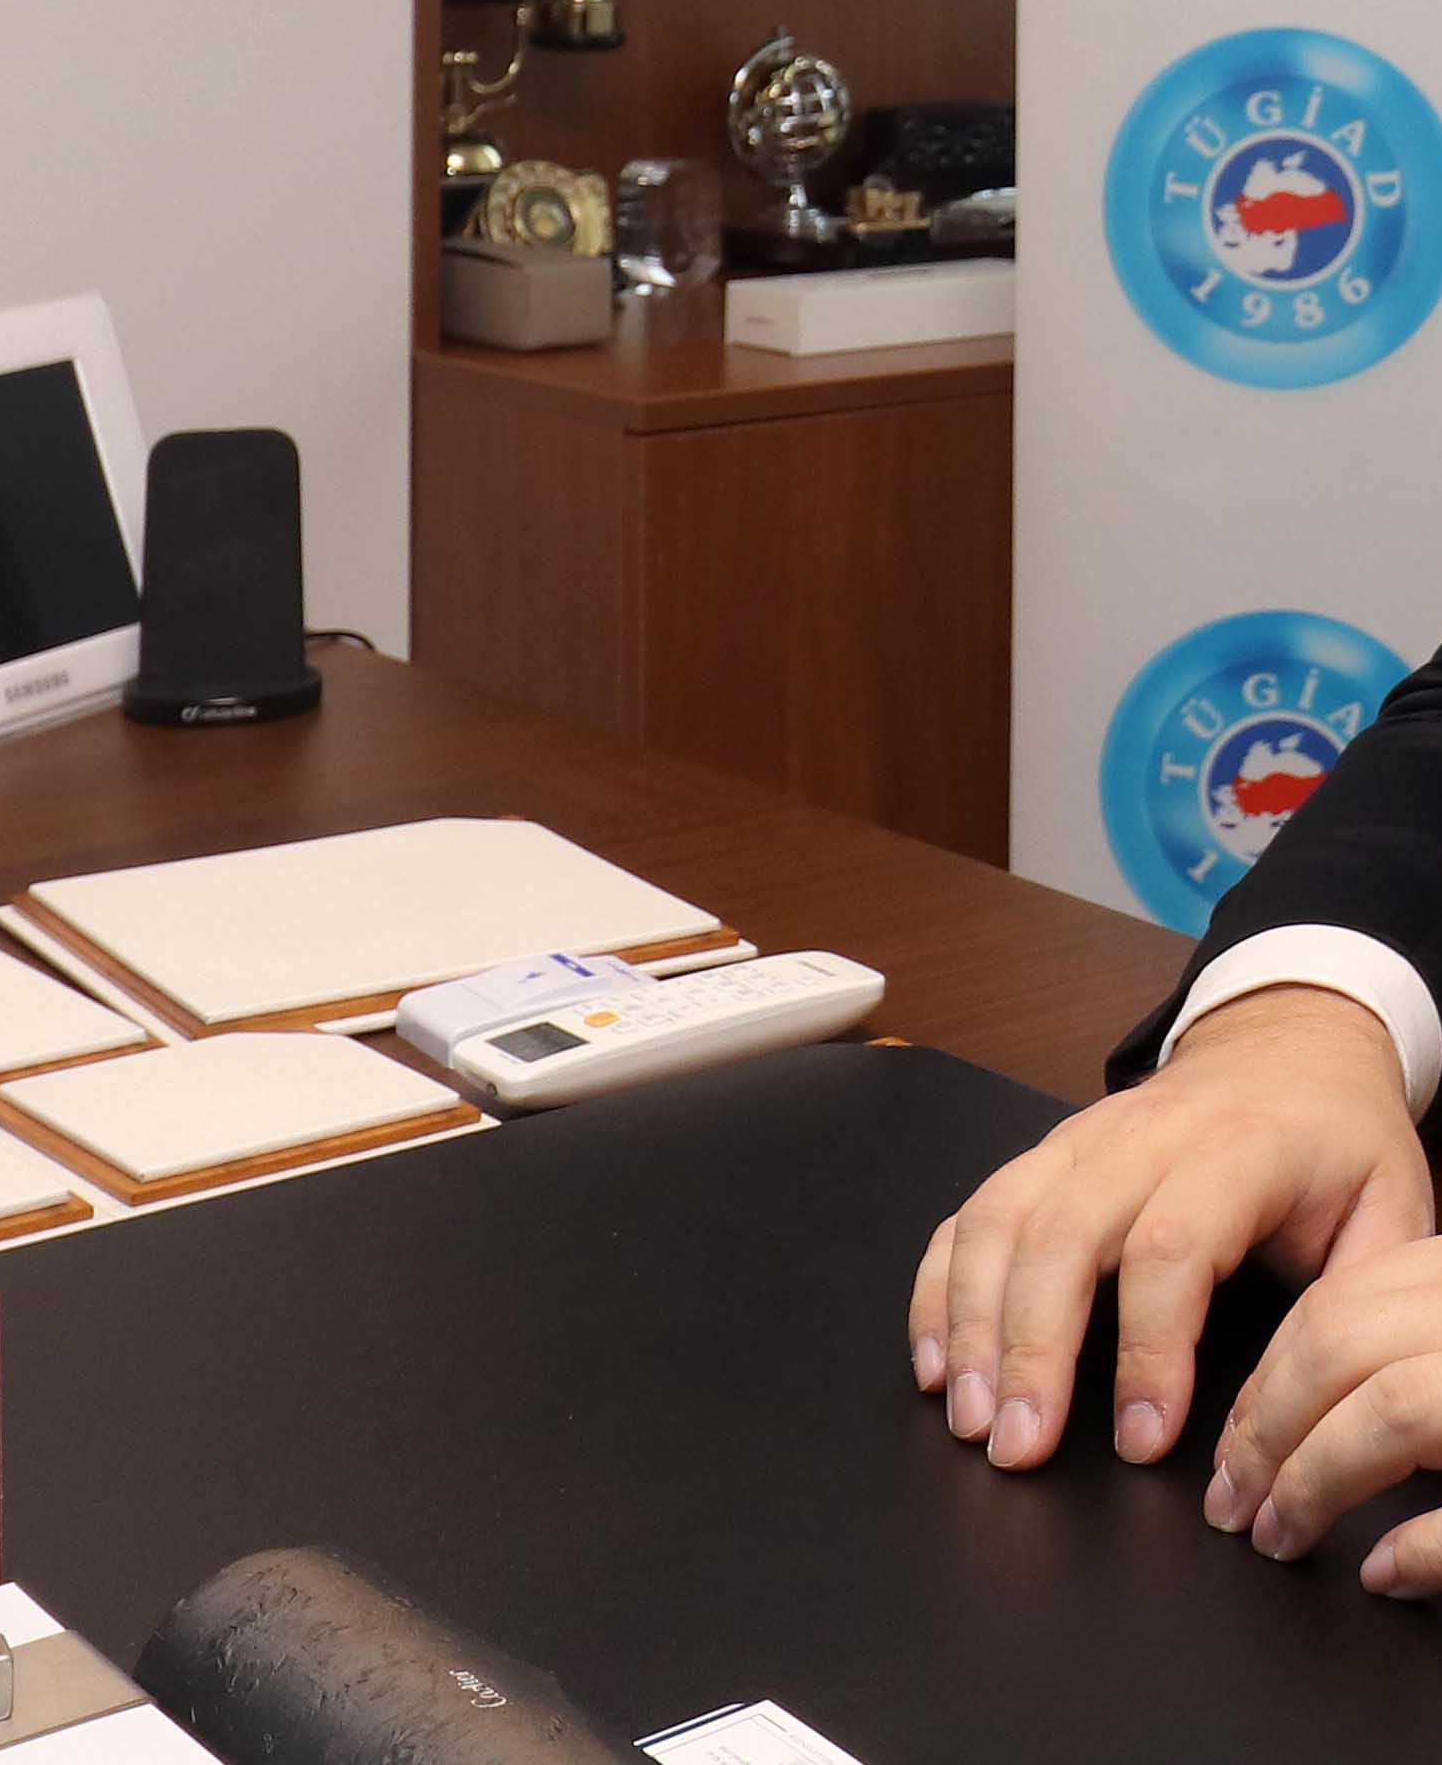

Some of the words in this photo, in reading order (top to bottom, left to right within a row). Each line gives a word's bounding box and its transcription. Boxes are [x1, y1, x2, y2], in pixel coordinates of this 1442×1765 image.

[1163, 87, 1401, 208] TÜGİAD
[1190, 267, 1372, 329] 1986
[1160, 667, 1362, 786] TÜGİA
